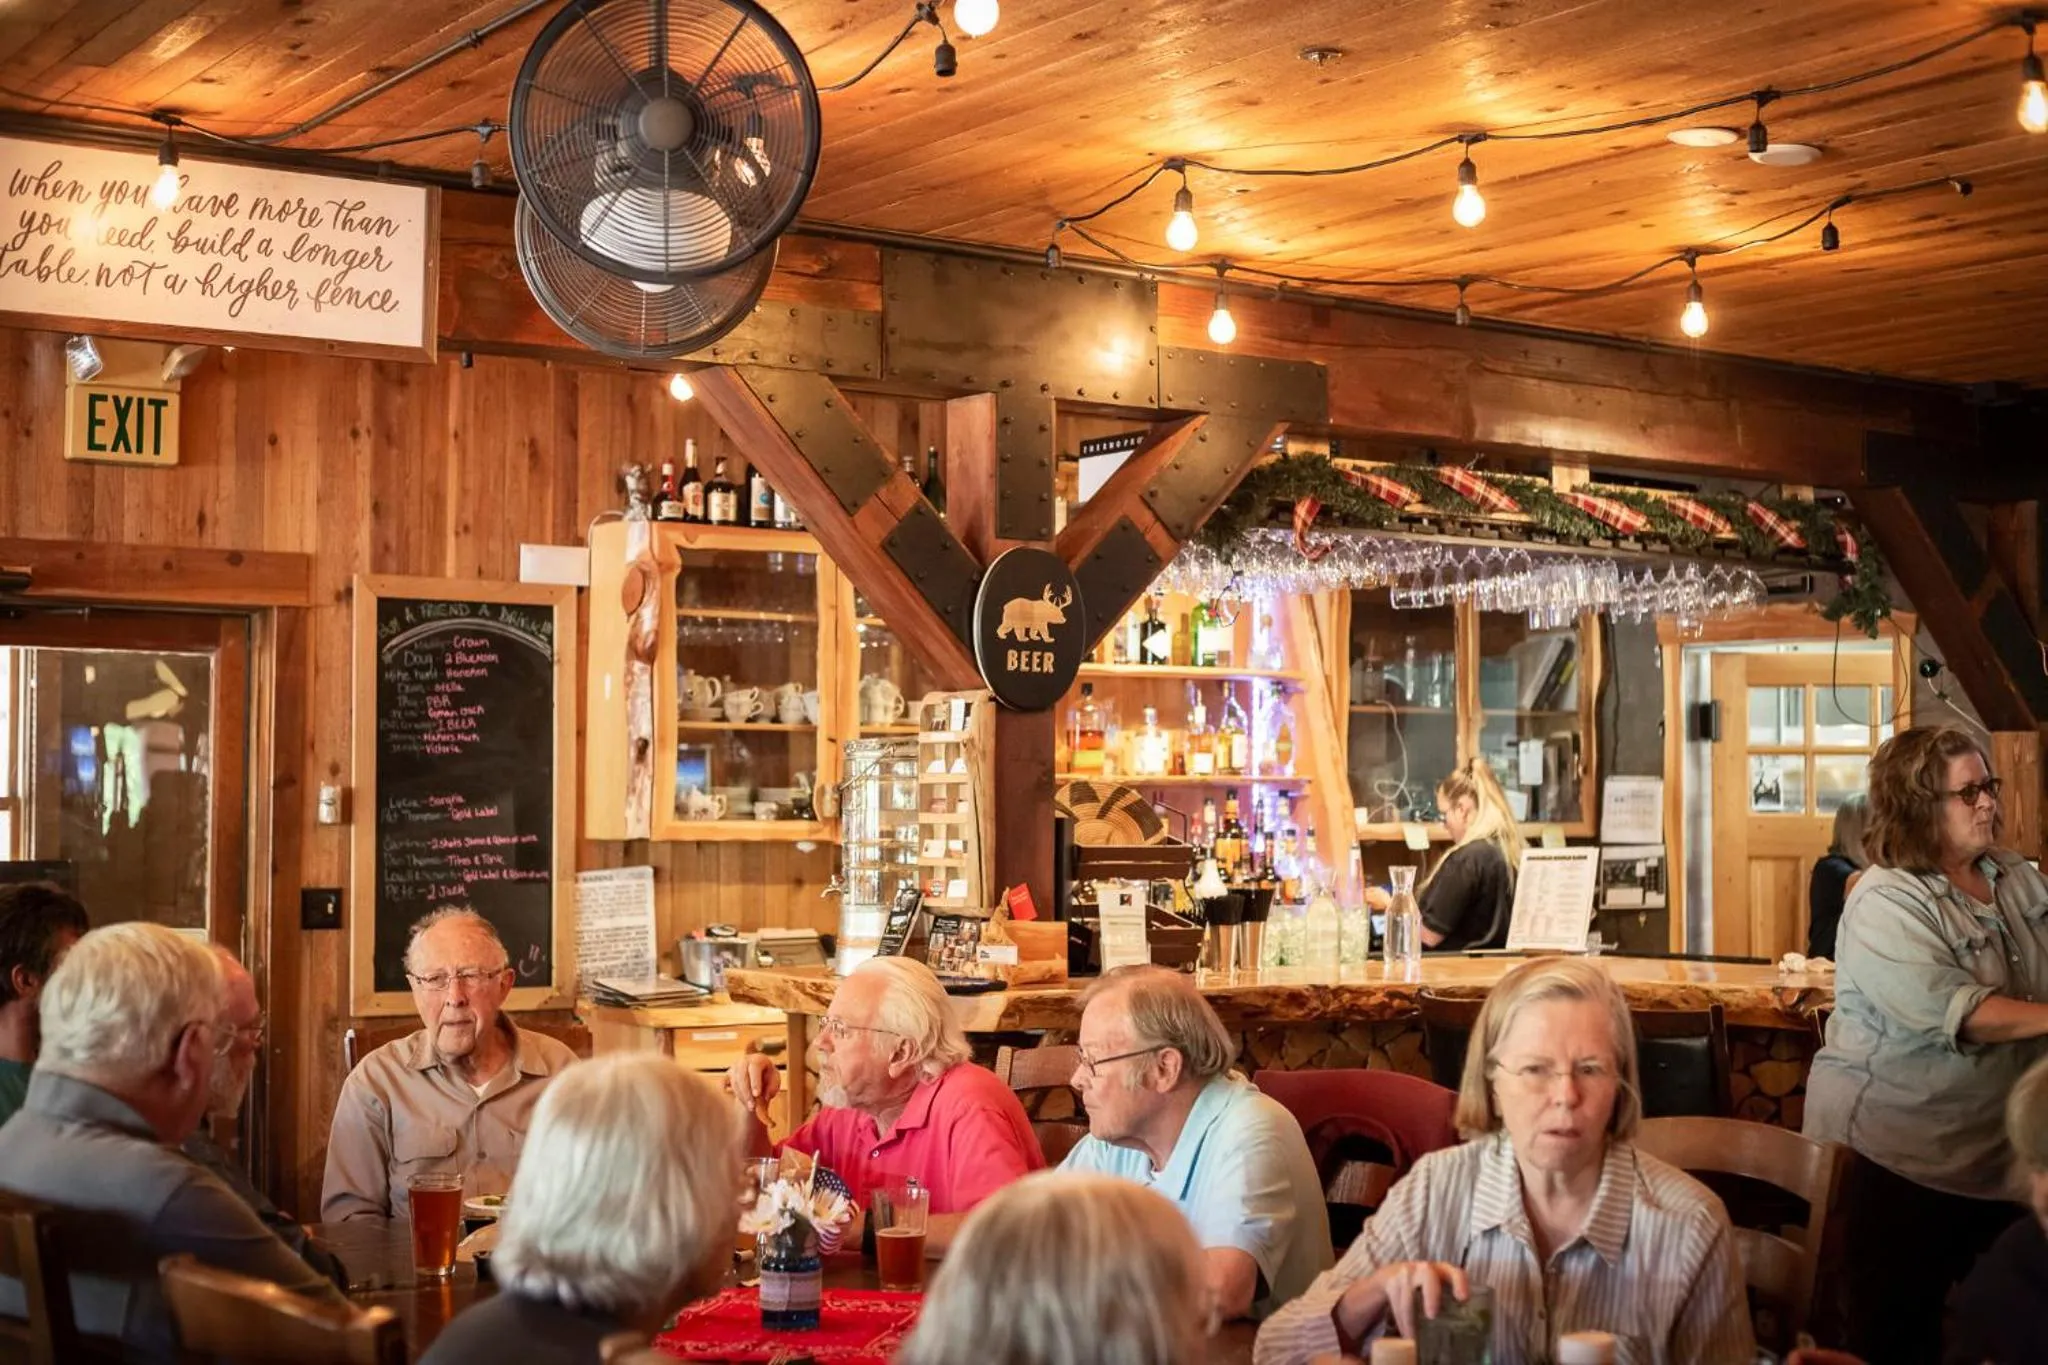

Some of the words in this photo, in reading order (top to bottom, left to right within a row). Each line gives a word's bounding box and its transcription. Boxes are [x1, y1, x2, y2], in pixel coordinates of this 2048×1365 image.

[9, 160, 92, 204] when
[91, 179, 152, 216] you
[249, 197, 324, 229] more
[326, 199, 400, 239] than
[12, 209, 71, 252] you
[167, 219, 249, 262] build
[257, 237, 275, 258] a
[283, 232, 393, 286] longer
[95, 260, 169, 295] not
[164, 273, 188, 295] a
[194, 262, 300, 318] higher
[87, 393, 169, 457] EXIT
[478, 603, 491, 617] A
[1006, 649, 1055, 674] BEER
